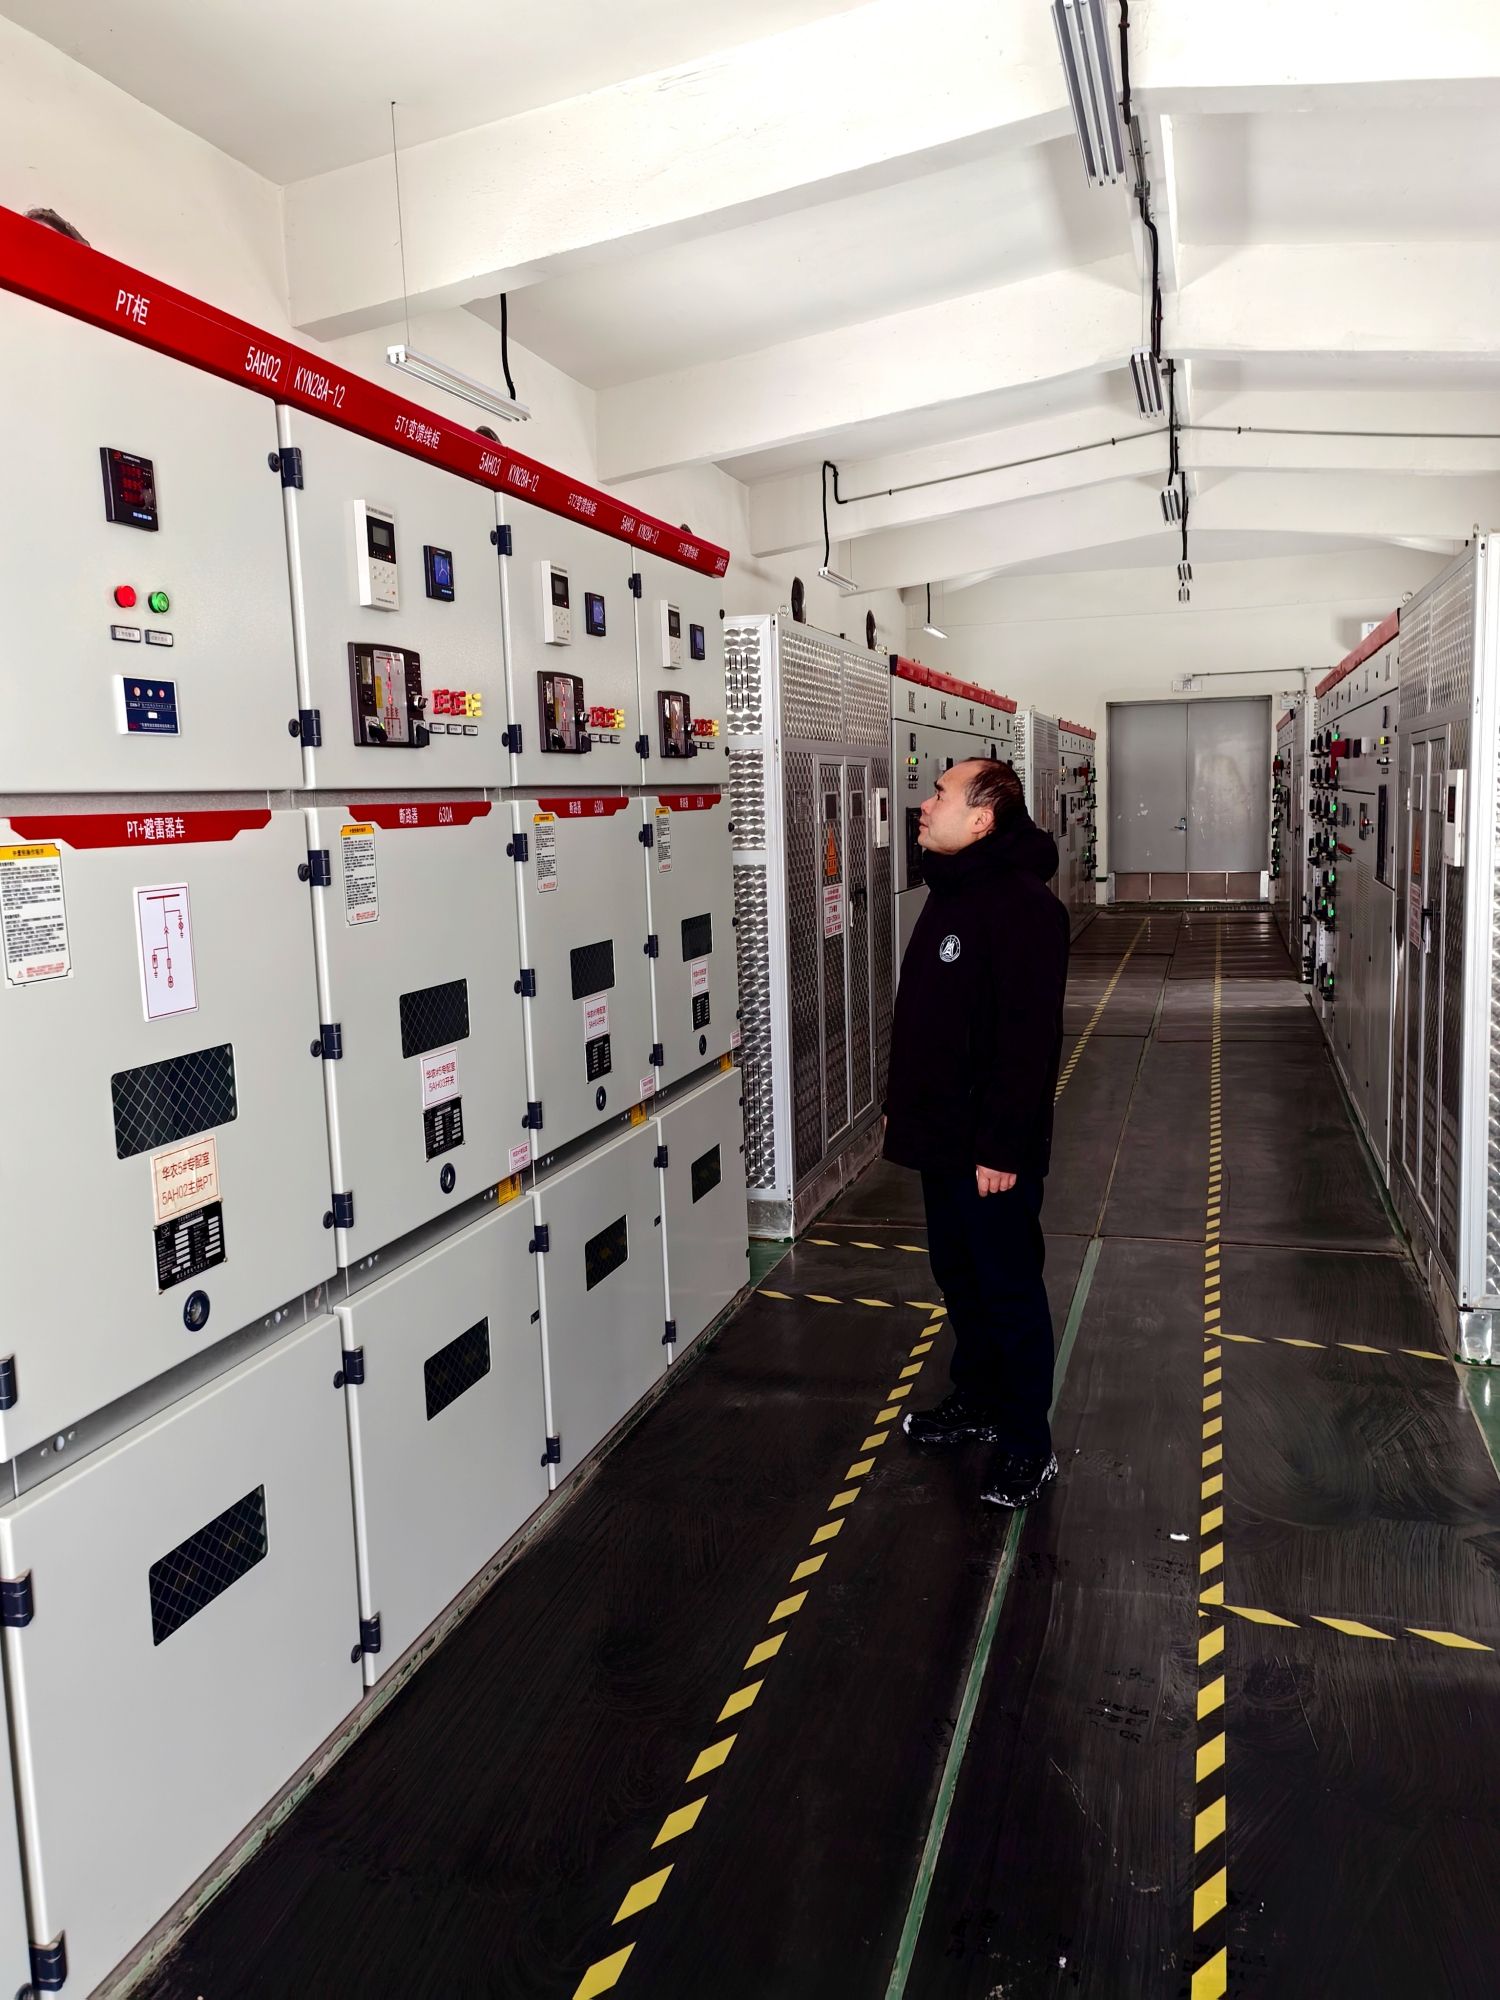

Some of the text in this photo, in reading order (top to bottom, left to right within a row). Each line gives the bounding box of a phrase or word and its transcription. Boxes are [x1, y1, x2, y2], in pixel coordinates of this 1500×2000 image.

[116, 289, 150, 326] PT柜
[245, 346, 282, 383] 5AH02
[294, 365, 346, 408] KYN28A-12
[394, 415, 442, 450] 5T1变馈线柜
[479, 451, 502, 477] 5AH03
[507, 463, 540, 493] KYN28A-12
[126, 817, 186, 840] PT+避雷器车
[438, 806, 454, 823] 630A
